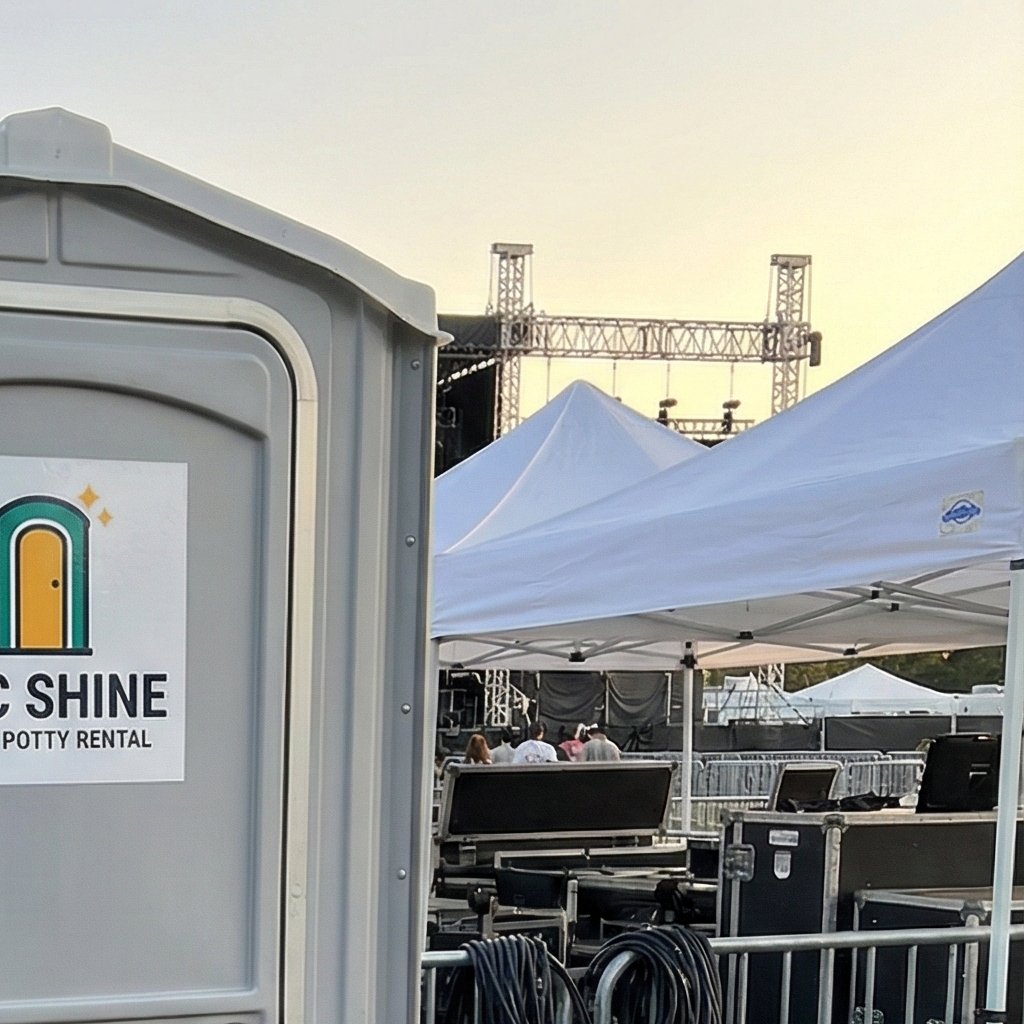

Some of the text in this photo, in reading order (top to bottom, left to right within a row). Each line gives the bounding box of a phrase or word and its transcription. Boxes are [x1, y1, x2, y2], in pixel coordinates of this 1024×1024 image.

[25, 673, 167, 719] SHINE
[2, 730, 70, 750] POTTY
[76, 729, 152, 749] RENTAL
